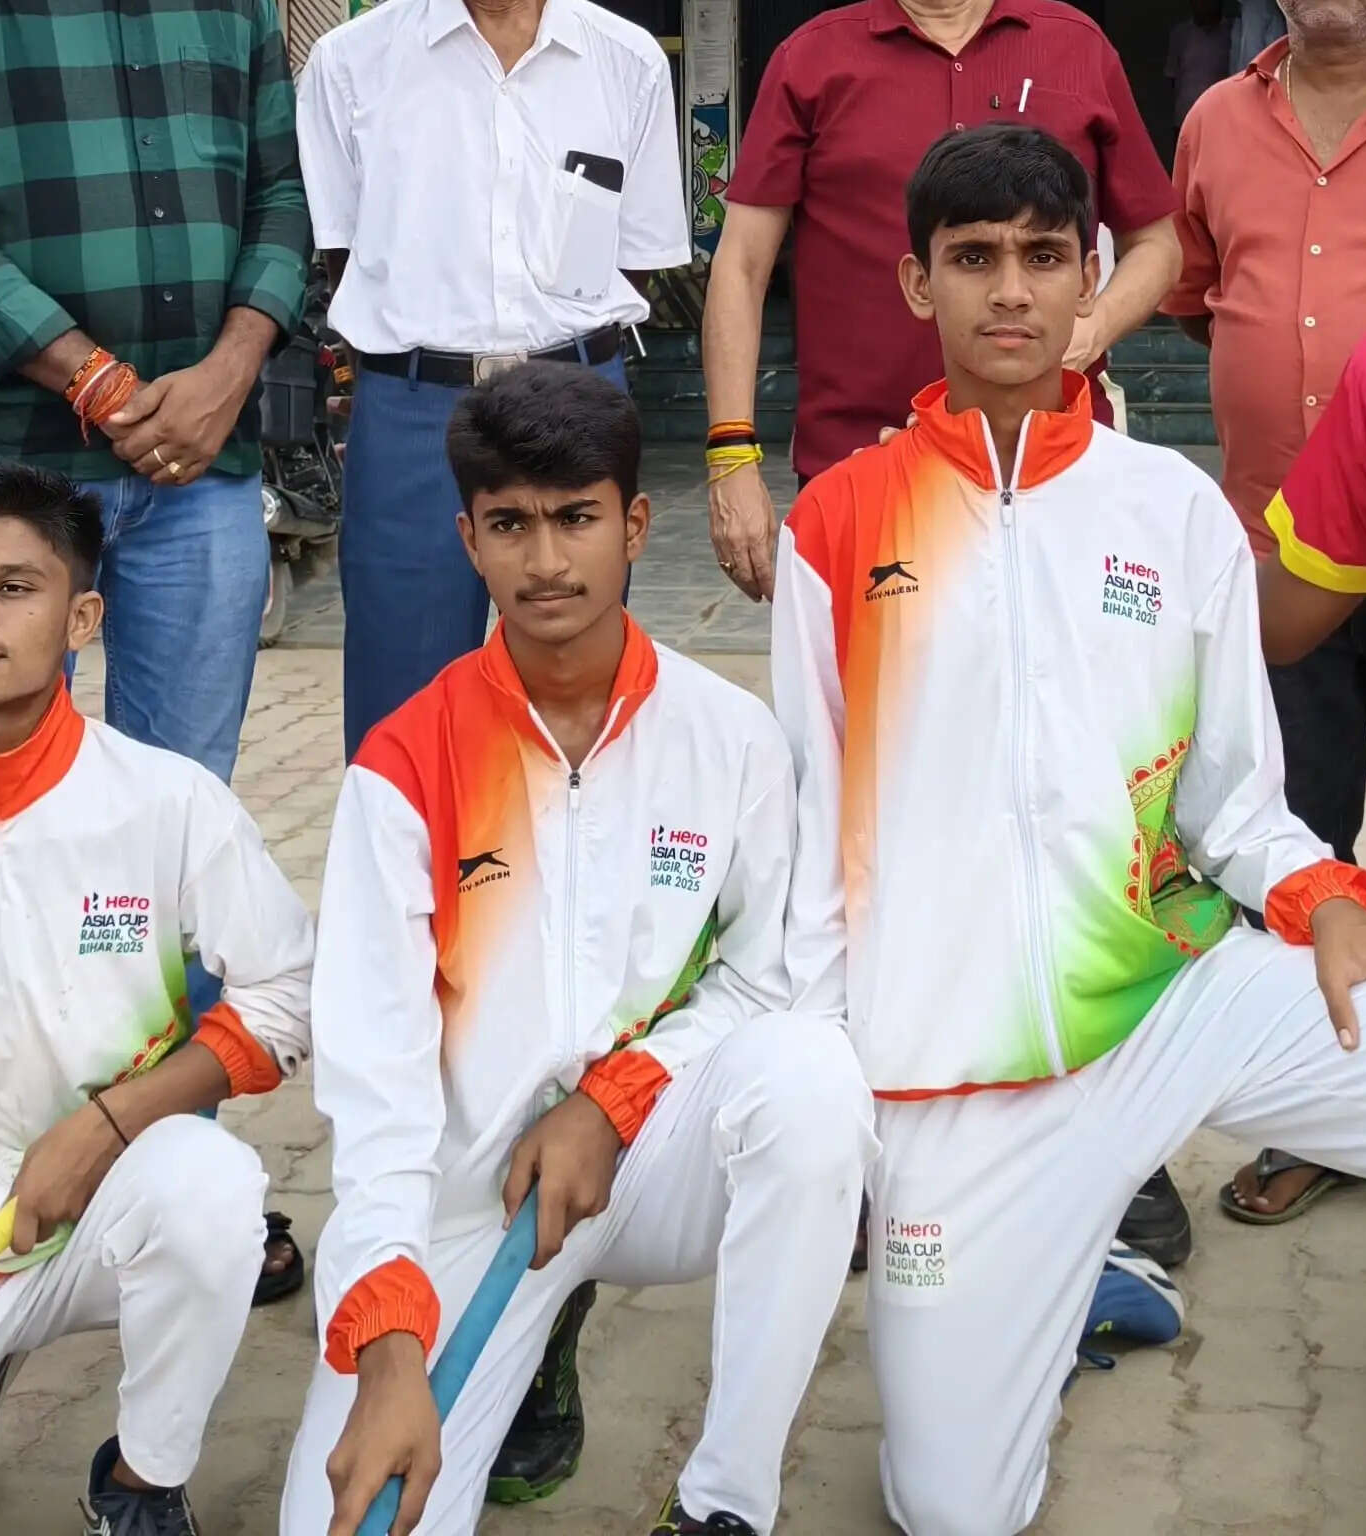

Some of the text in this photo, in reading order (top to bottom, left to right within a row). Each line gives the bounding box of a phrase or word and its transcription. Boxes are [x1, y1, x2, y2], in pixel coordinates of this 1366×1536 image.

[1124, 561, 1160, 582] Hero
[1104, 574, 1161, 598] ASIA CUP
[1102, 601, 1158, 625] BIHAR 2025
[669, 830, 708, 847] Hero
[651, 846, 706, 864] ASIA CUP
[675, 875, 701, 892] 2025
[106, 895, 150, 910] Hero
[82, 913, 148, 927] ASIA CUP
[116, 941, 144, 953] 2025
[900, 1221, 942, 1238] Hero
[886, 1239, 942, 1257] ASIA CUP
[916, 1272, 945, 1287] 2025
